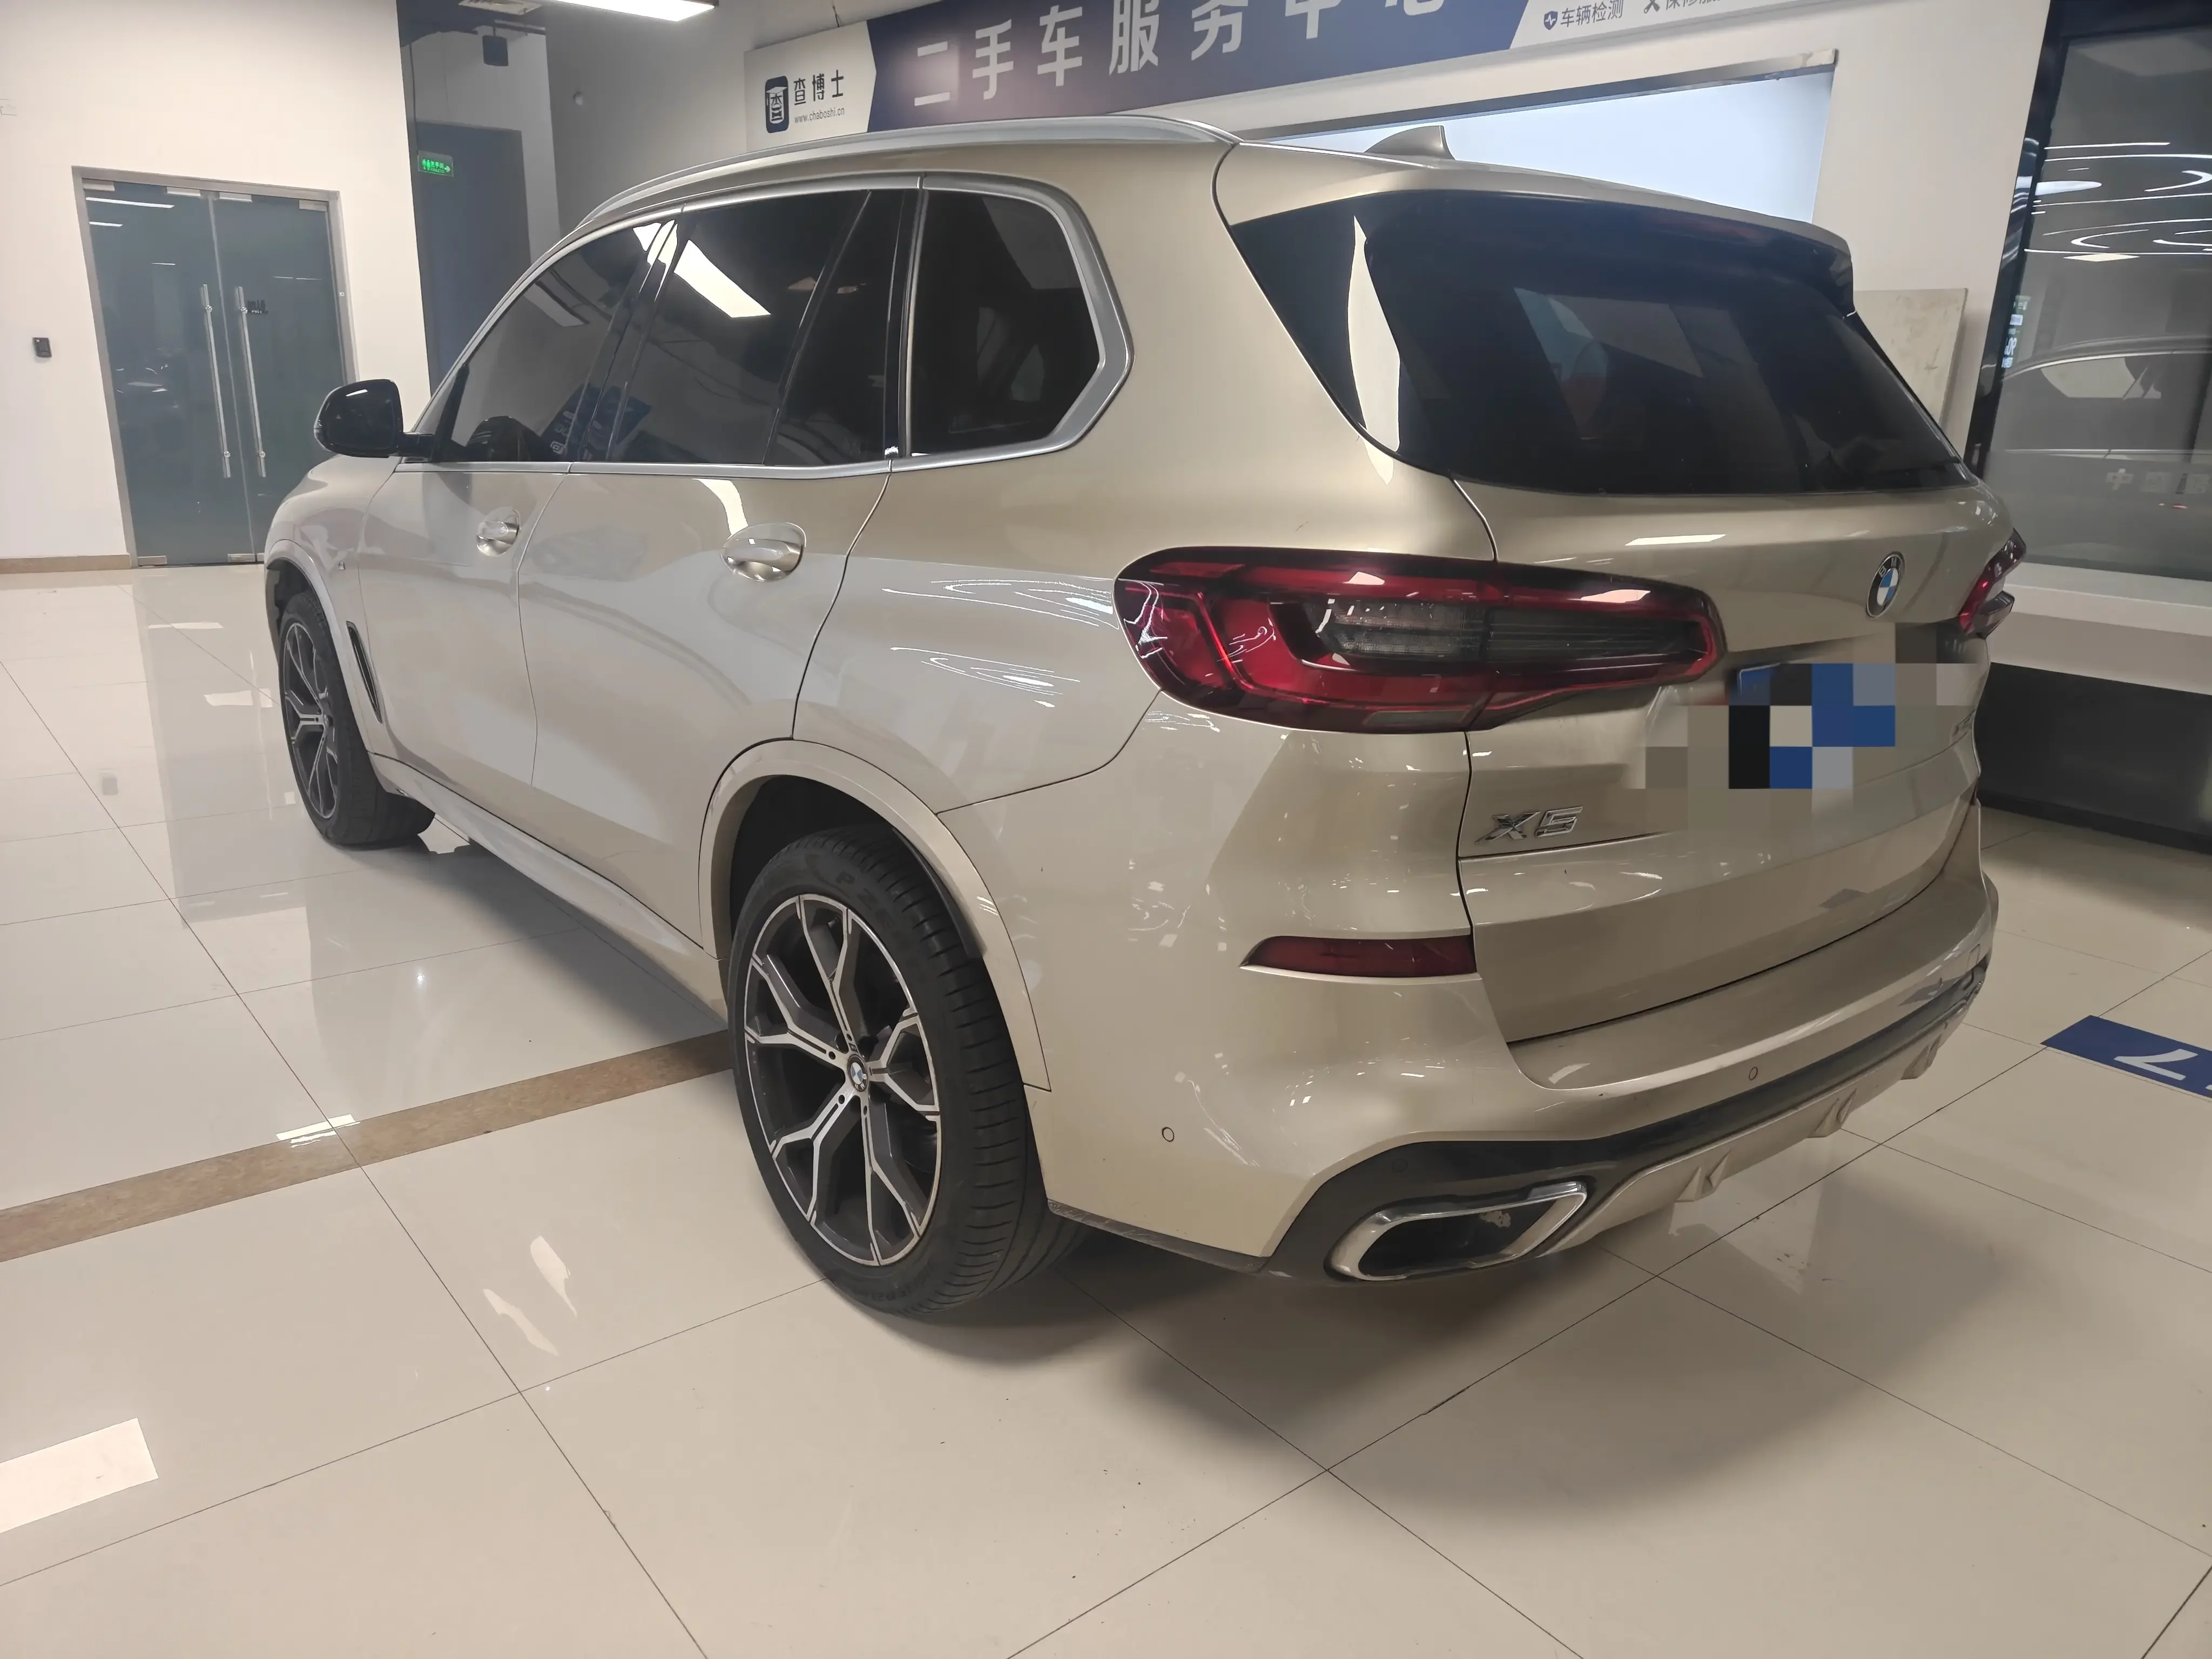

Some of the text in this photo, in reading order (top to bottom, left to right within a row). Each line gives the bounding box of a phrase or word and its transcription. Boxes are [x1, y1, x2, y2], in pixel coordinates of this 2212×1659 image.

[1560, 0, 1624, 27] 车辆检测
[914, 0, 1445, 106] 二手车服务
[793, 69, 845, 105] 查博士
[794, 107, 845, 124] www.chaboshi.cn
[1474, 806, 1583, 845] X5
[2114, 1048, 2212, 1091] 7
